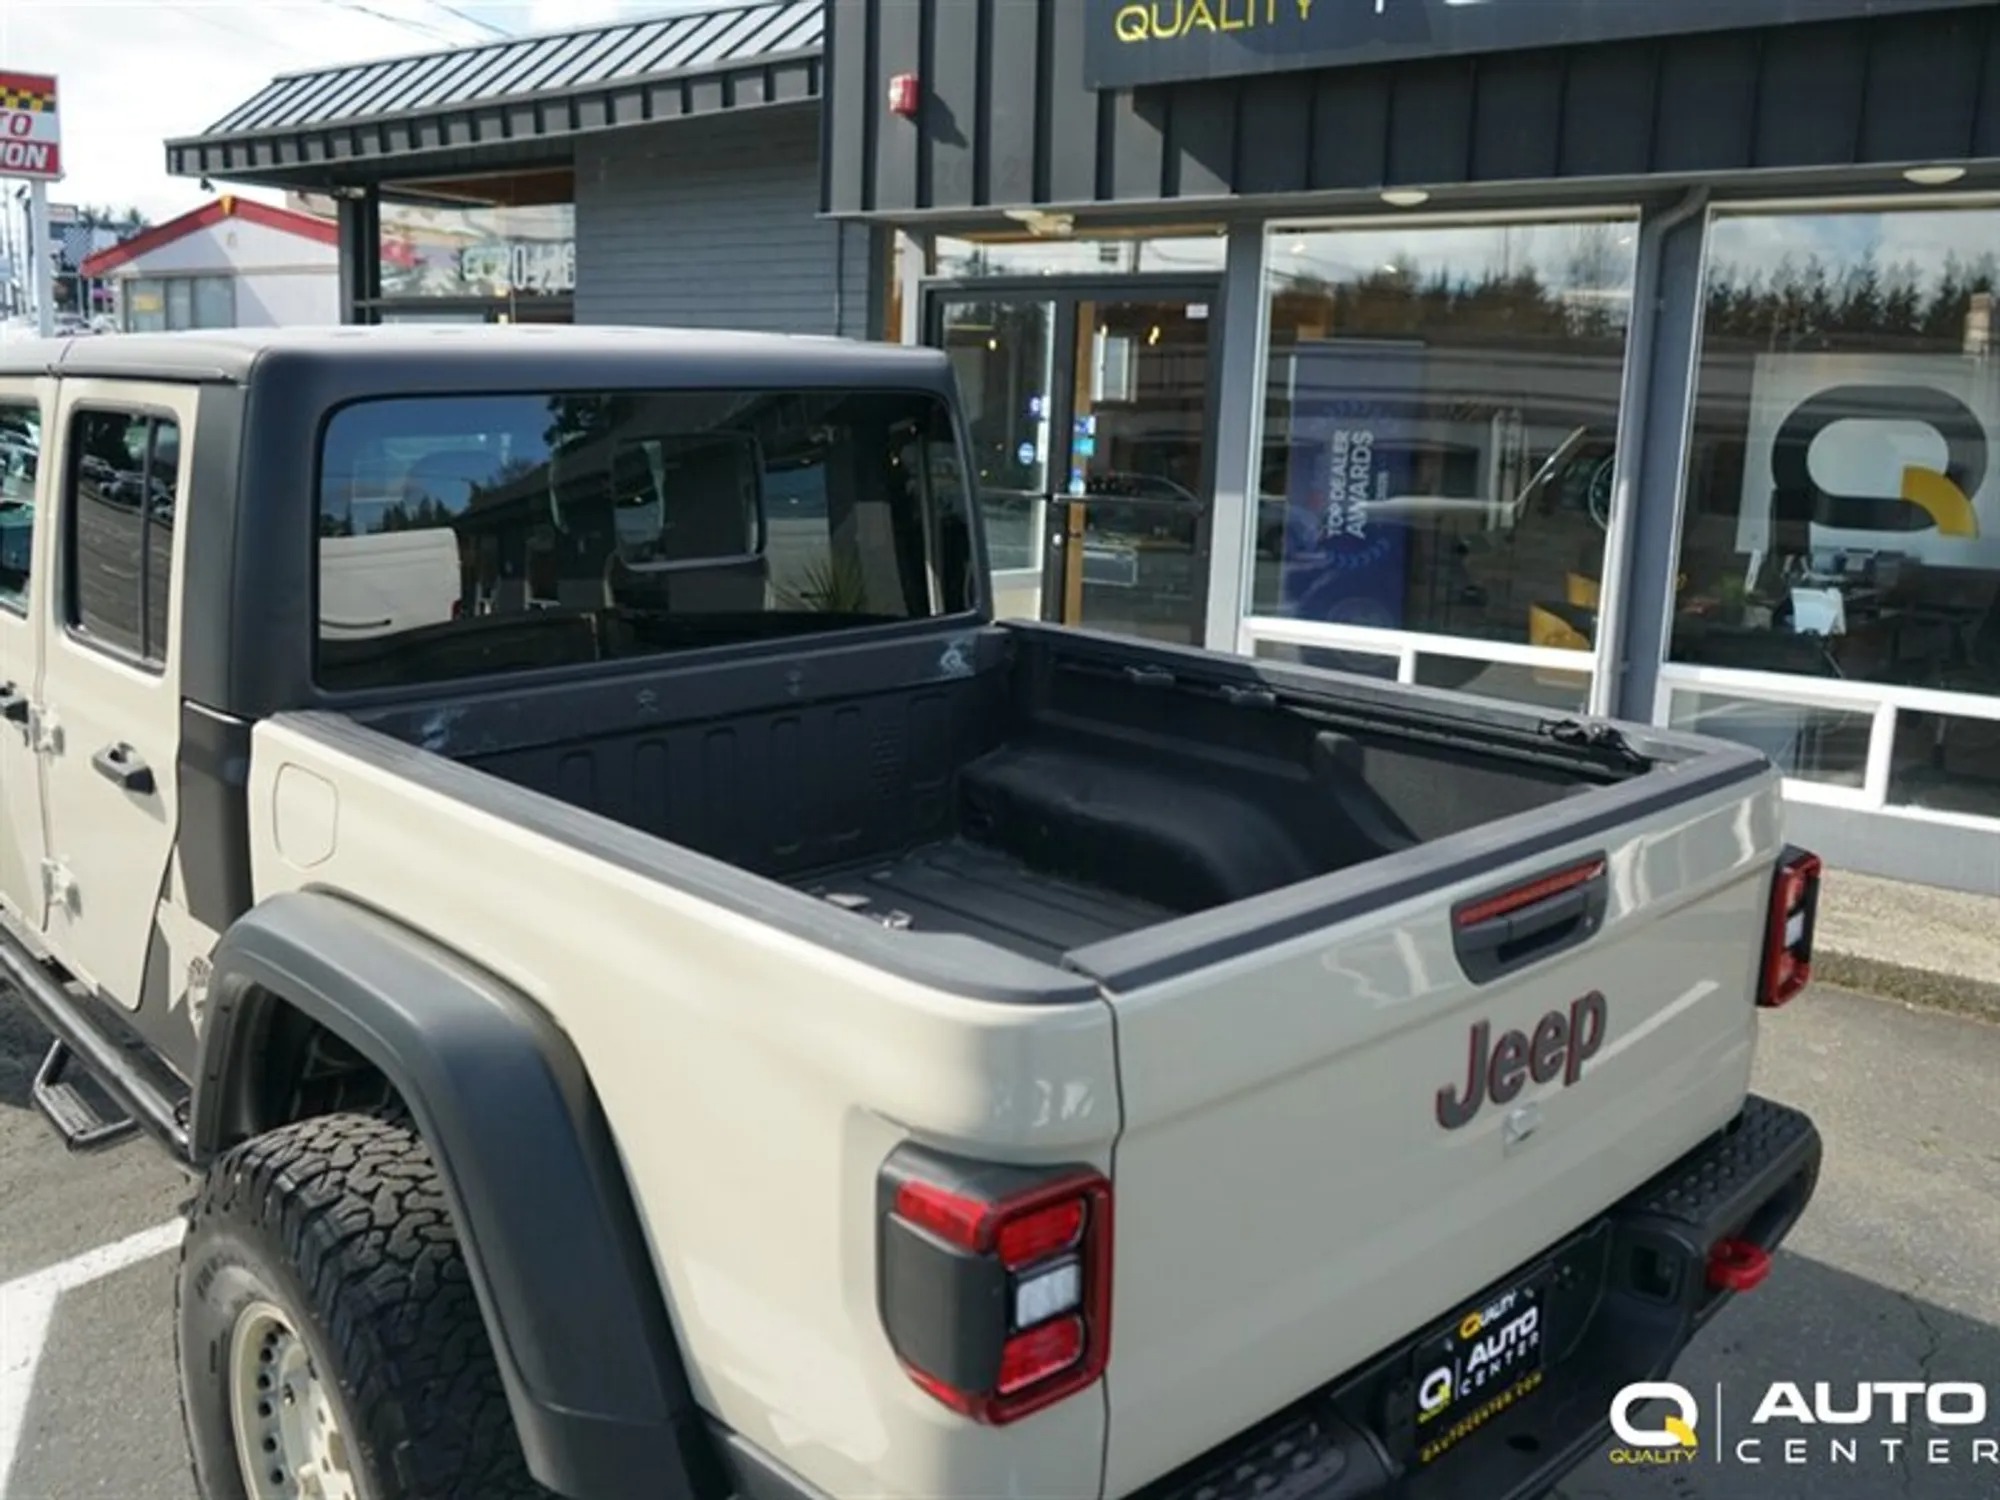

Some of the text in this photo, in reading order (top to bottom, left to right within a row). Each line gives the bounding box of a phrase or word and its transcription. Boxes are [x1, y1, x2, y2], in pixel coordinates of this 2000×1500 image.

[1115, 0, 1311, 42] QUALITY
[1327, 430, 1350, 536] TOP DEALER
[1346, 431, 1374, 538] AWARDS
[1436, 989, 1608, 1131] Jeep
[1460, 1331, 1540, 1396] CENTER
[1466, 1306, 1539, 1374] AUTO
